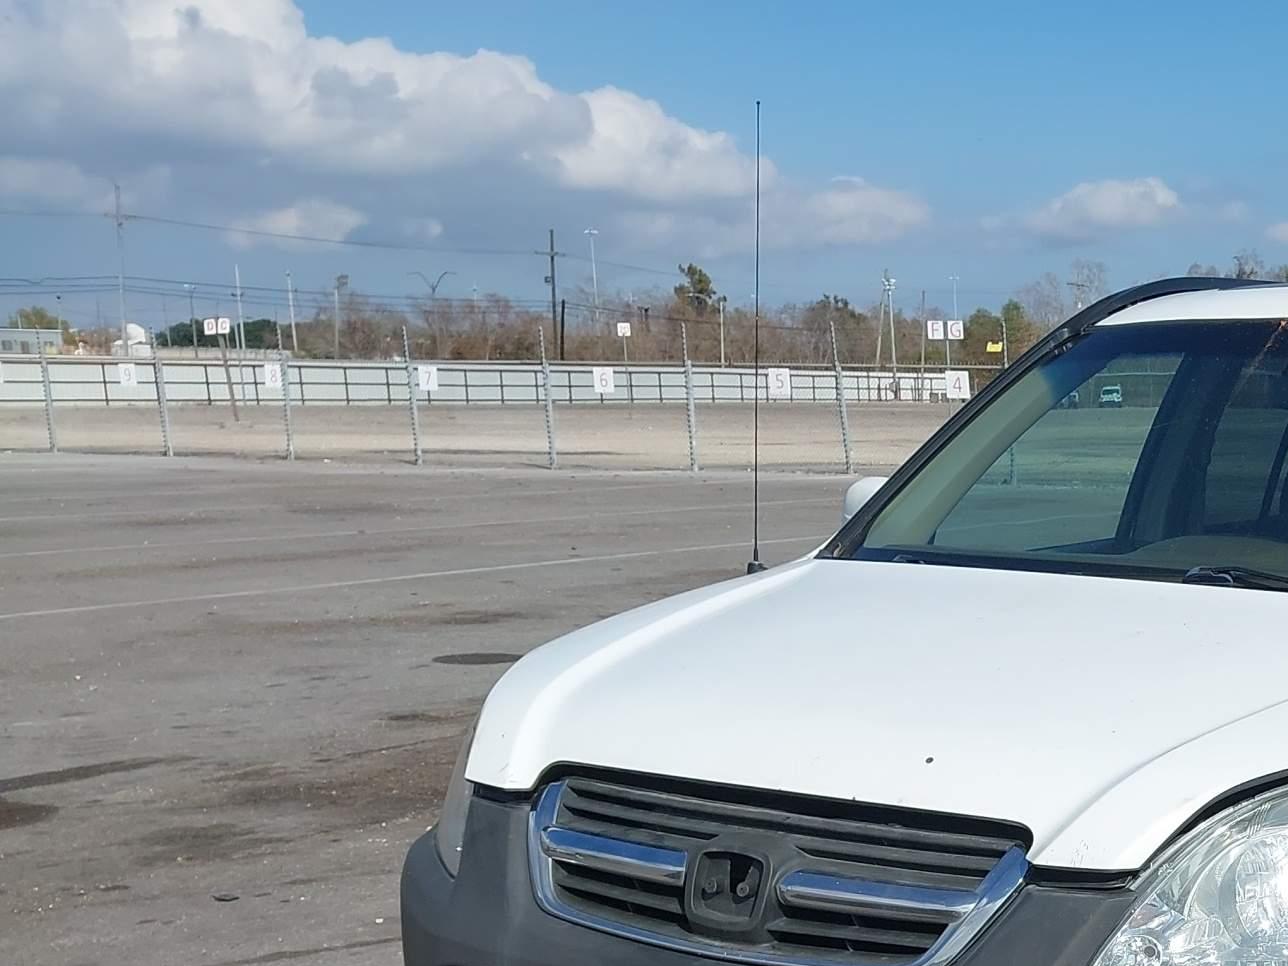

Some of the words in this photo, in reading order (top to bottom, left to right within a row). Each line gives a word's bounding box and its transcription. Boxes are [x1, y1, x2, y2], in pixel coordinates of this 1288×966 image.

[931, 322, 940, 338] F
[950, 322, 961, 338] G
[123, 368, 132, 383] 9
[270, 368, 278, 383] 8
[424, 371, 432, 386] 7
[600, 372, 608, 388] 6
[776, 374, 784, 389] 5
[953, 377, 962, 393] 4
